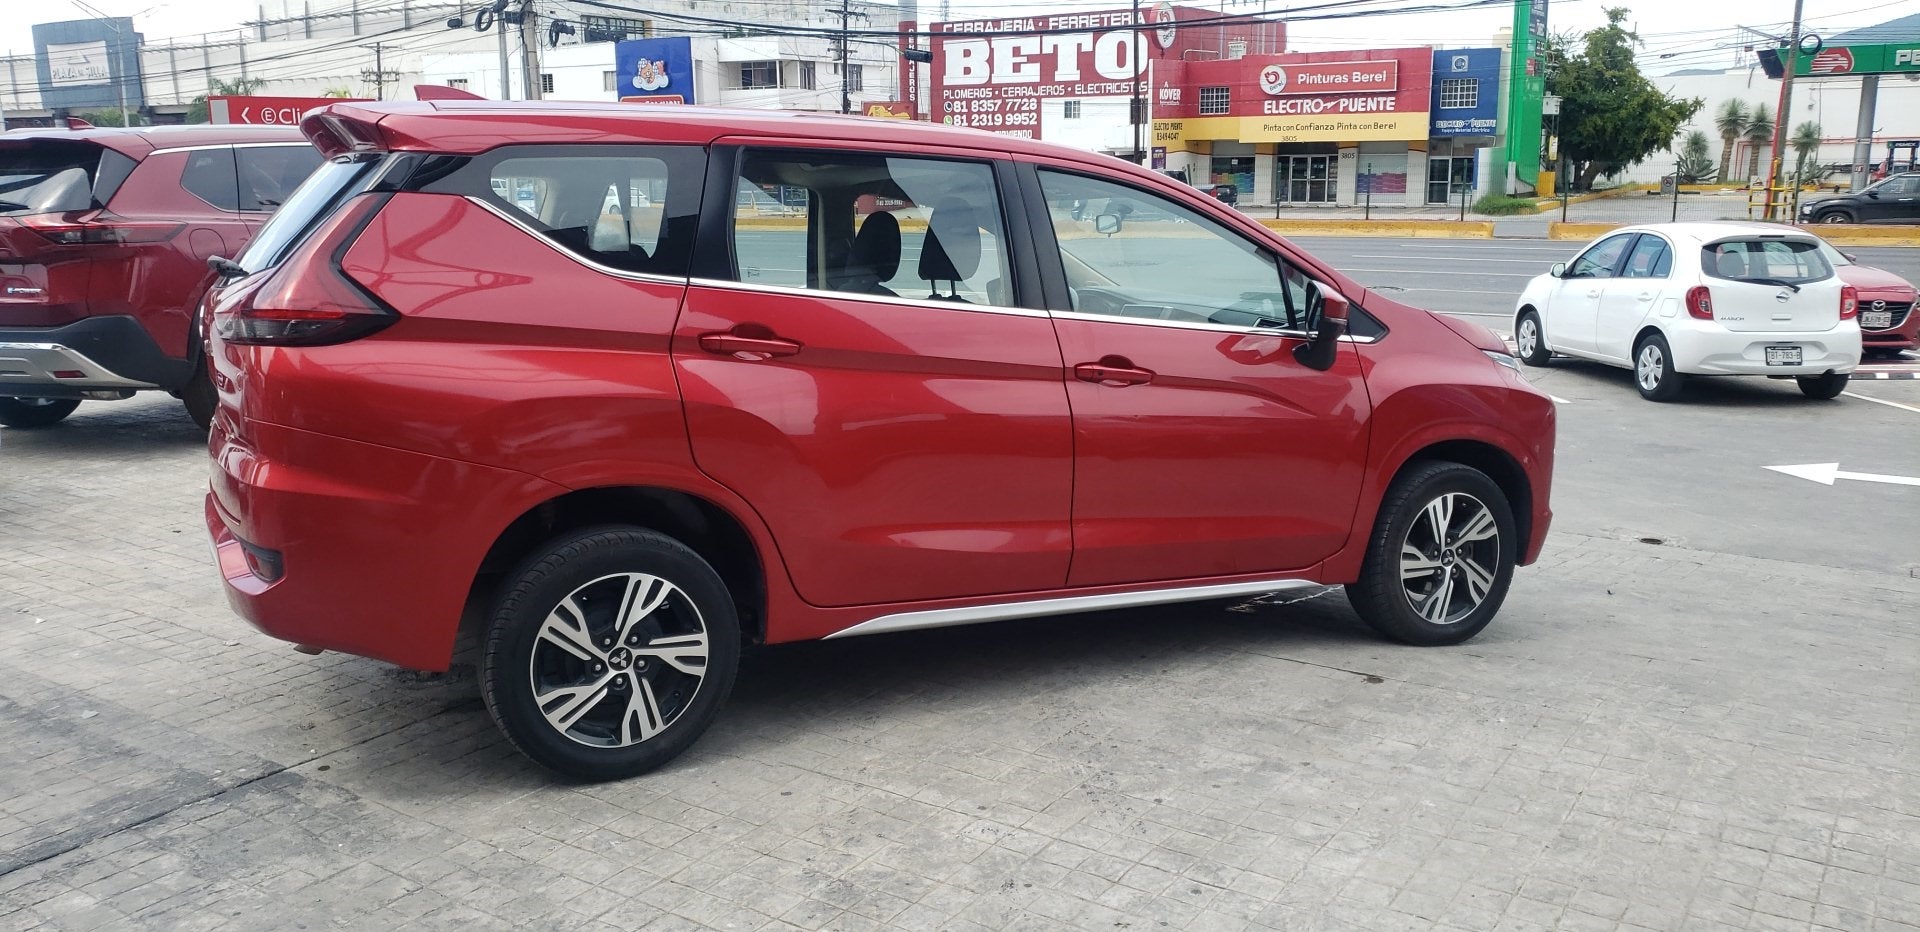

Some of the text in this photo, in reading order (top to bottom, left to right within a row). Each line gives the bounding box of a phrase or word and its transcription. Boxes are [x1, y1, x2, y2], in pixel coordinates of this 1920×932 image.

[943, 30, 1148, 85] BETO
[1297, 70, 1387, 84] Pinturas Berel
[943, 88, 993, 99] PLOMEROS
[1002, 85, 1065, 97] CERRAJEROS
[953, 98, 1038, 112] 81 8357 7728
[1264, 97, 1396, 114] ELECTRO PUENTE
[953, 112, 1038, 126] 81 2319 9952
[1154, 123, 1170, 131] ELECTRO
[1263, 124, 1281, 132] Pinta
[1295, 123, 1335, 131] Confianza
[1373, 122, 1397, 130] Berel
